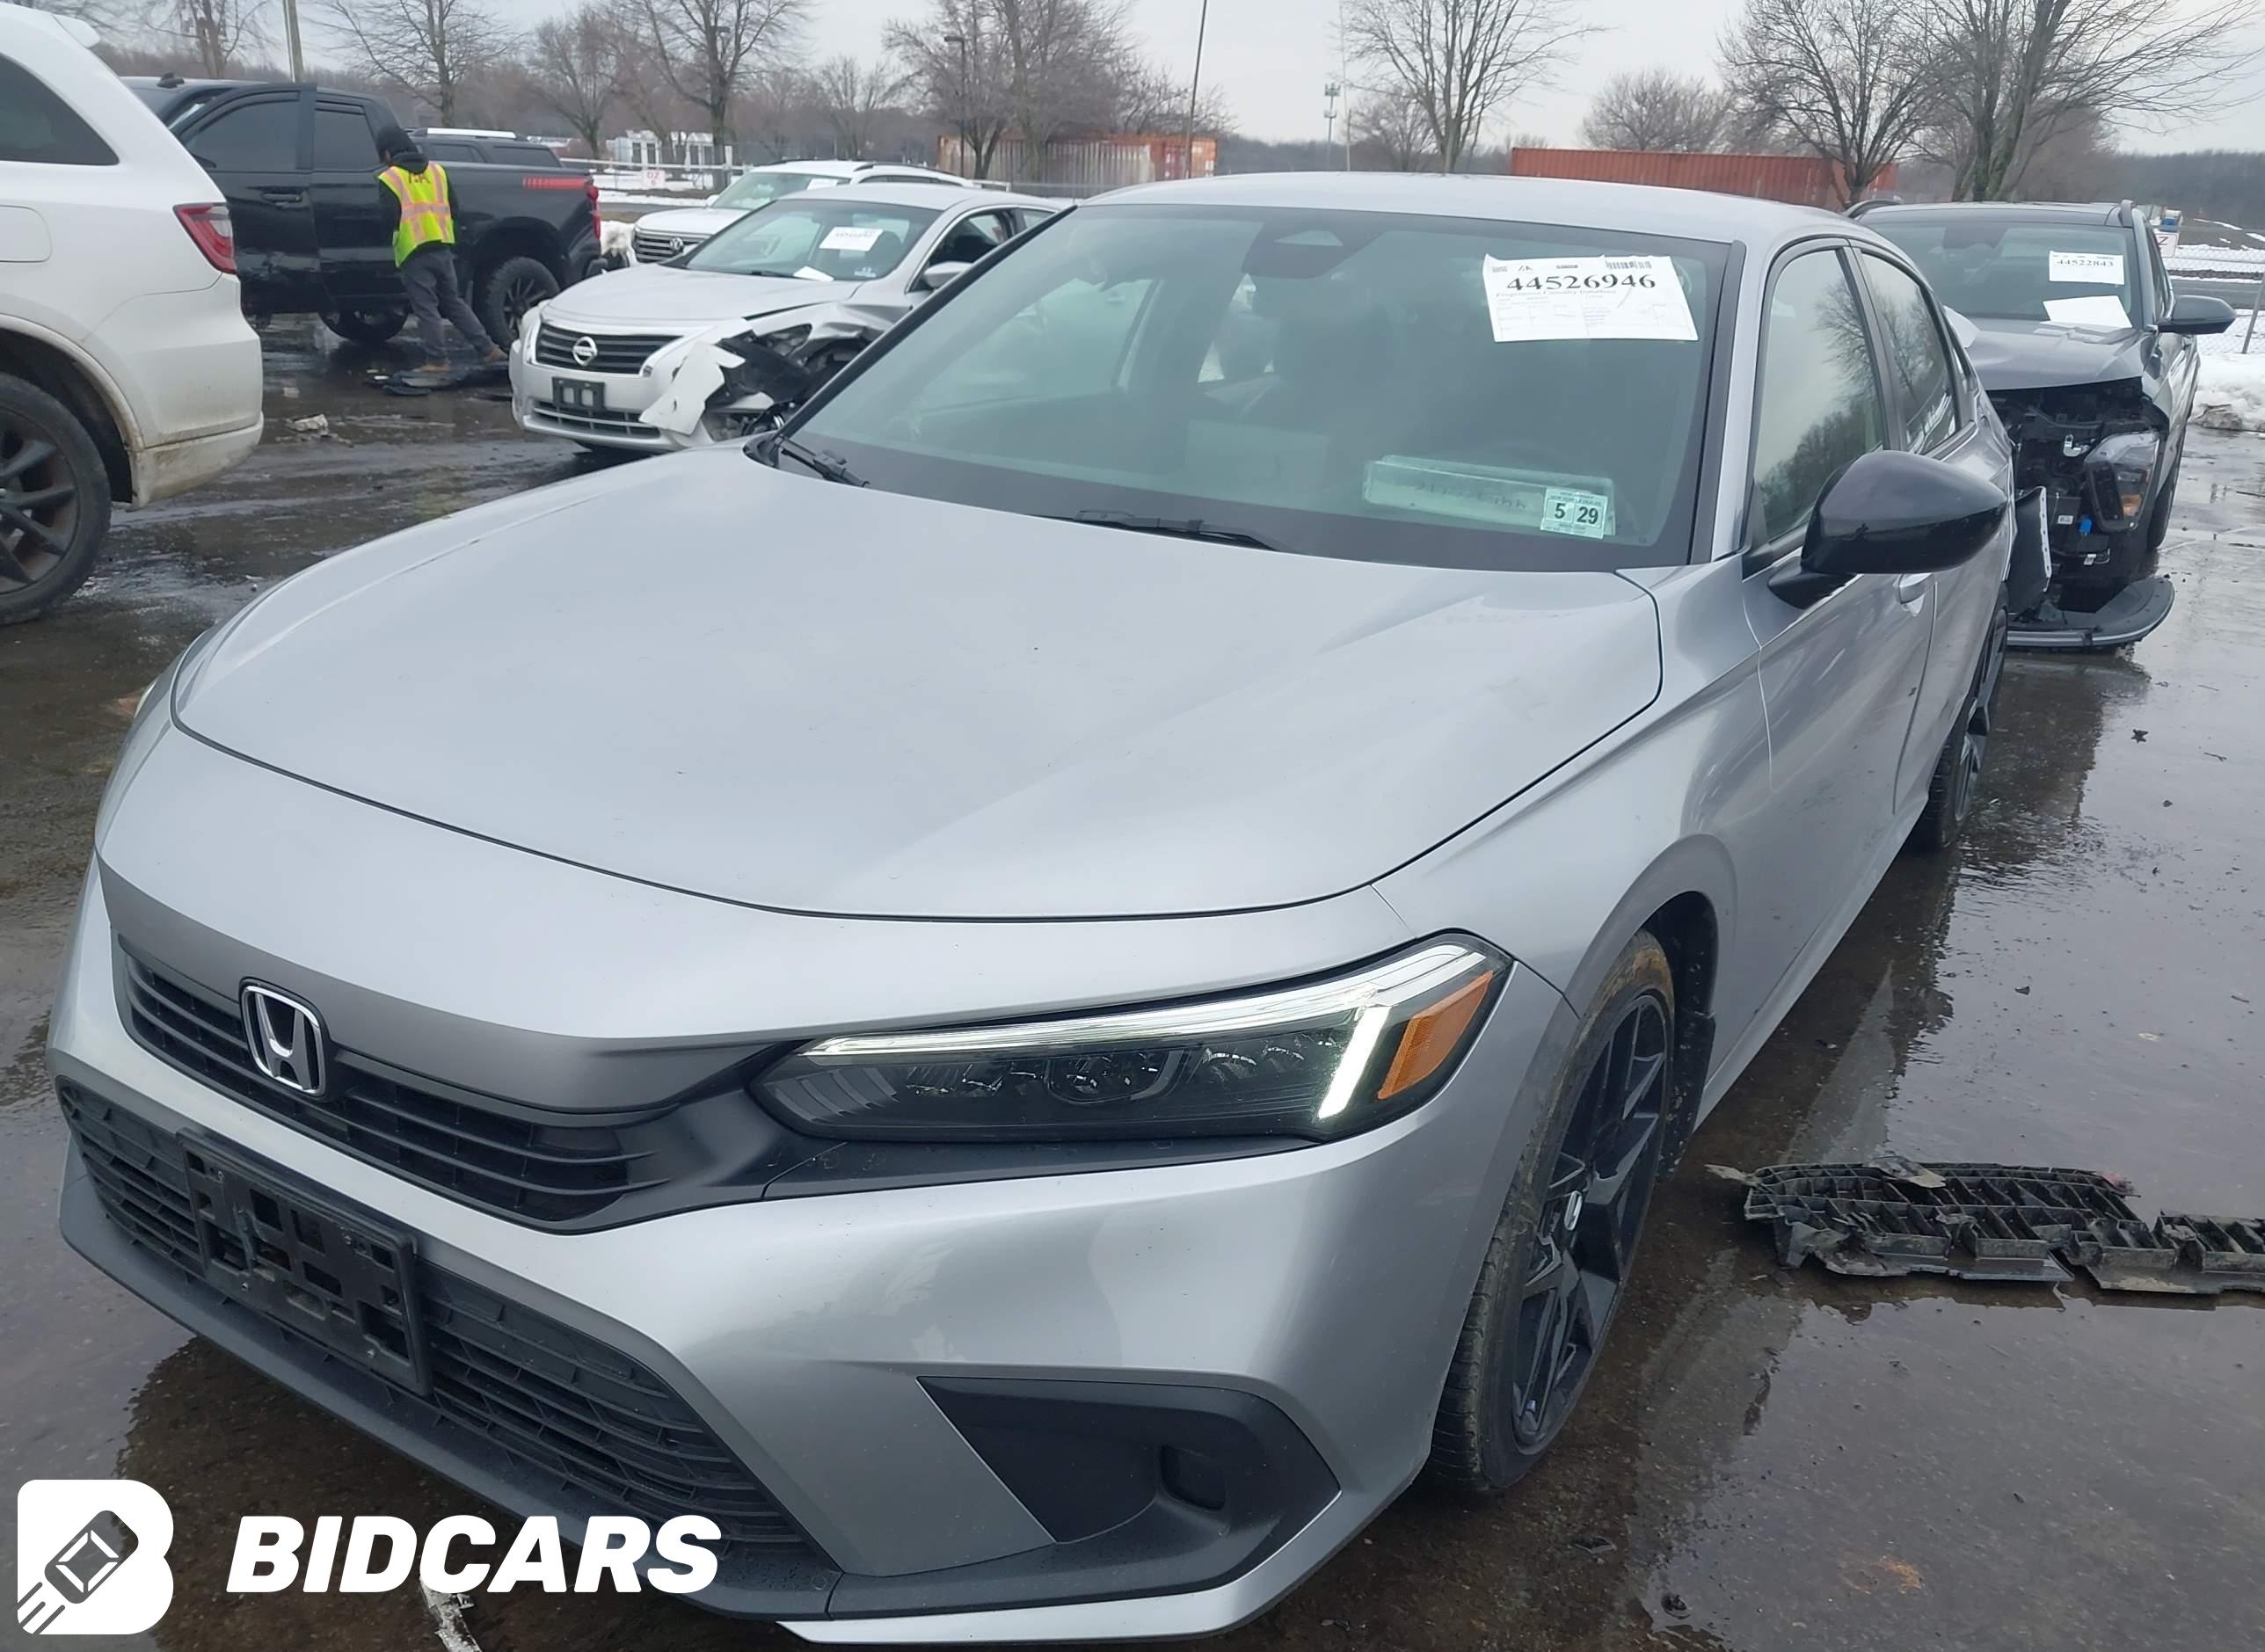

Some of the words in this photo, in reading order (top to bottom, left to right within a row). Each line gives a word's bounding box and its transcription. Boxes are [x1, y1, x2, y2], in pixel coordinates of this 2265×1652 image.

[1507, 273, 1656, 290] 44526946
[1555, 503, 1565, 519] 5
[1577, 506, 1599, 525] 29
